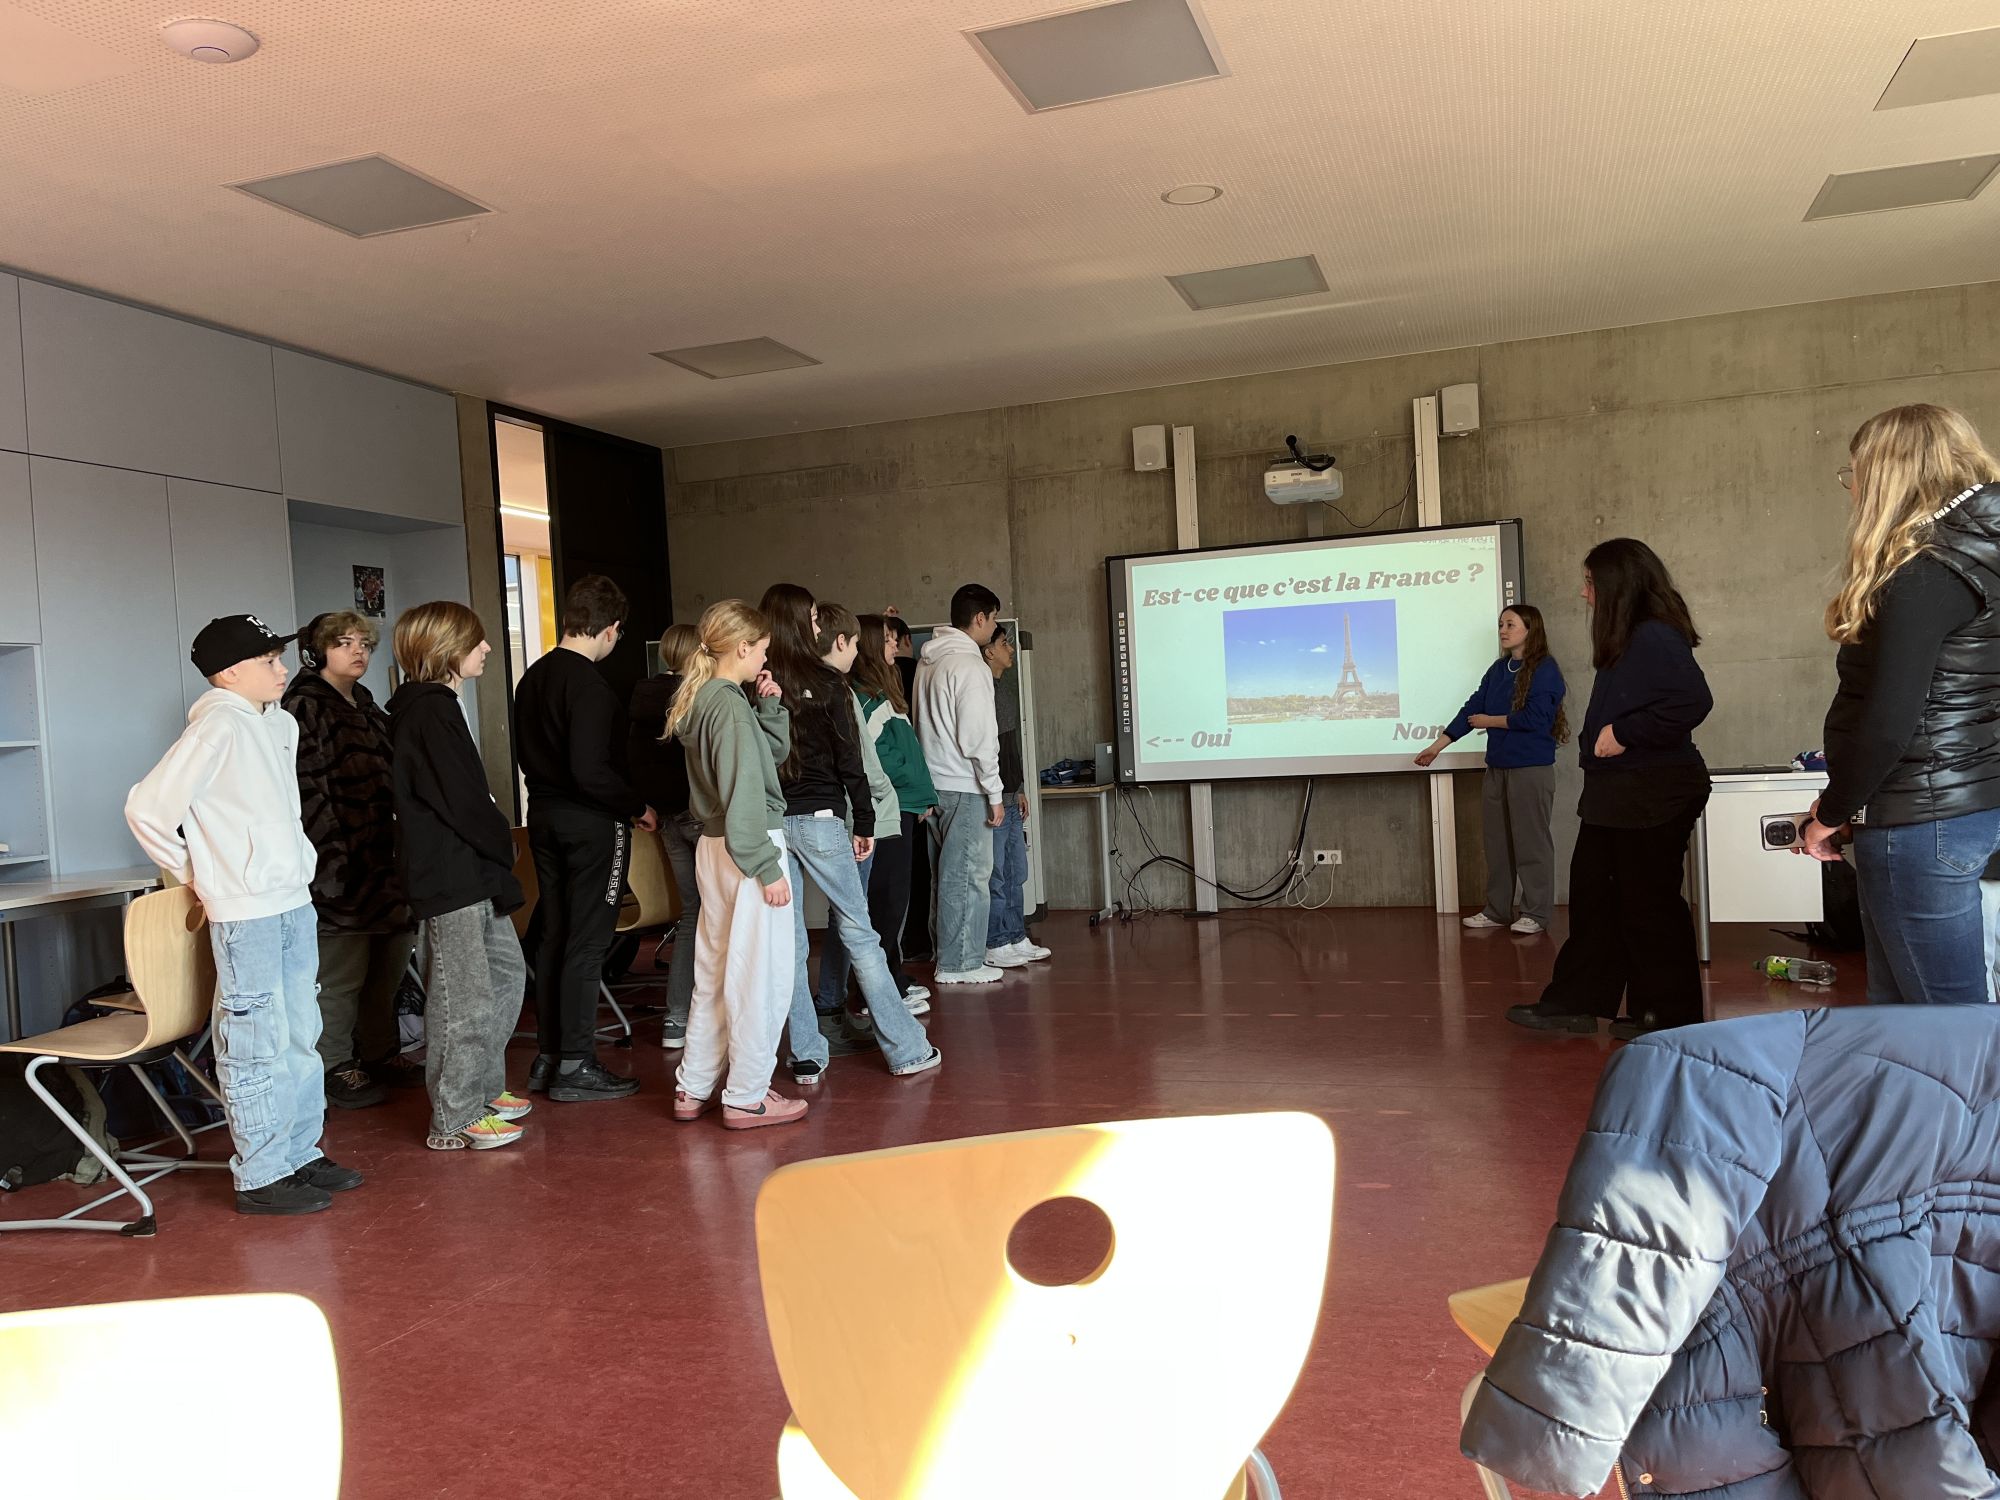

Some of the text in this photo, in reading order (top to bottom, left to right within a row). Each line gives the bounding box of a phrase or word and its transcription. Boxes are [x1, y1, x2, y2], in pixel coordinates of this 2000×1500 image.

[1142, 587, 1220, 607] Est-ce
[1223, 582, 1270, 604] que
[1335, 571, 1361, 592] la
[1365, 568, 1461, 590] France
[1467, 562, 1485, 583] ?
[1190, 727, 1233, 749] Oui
